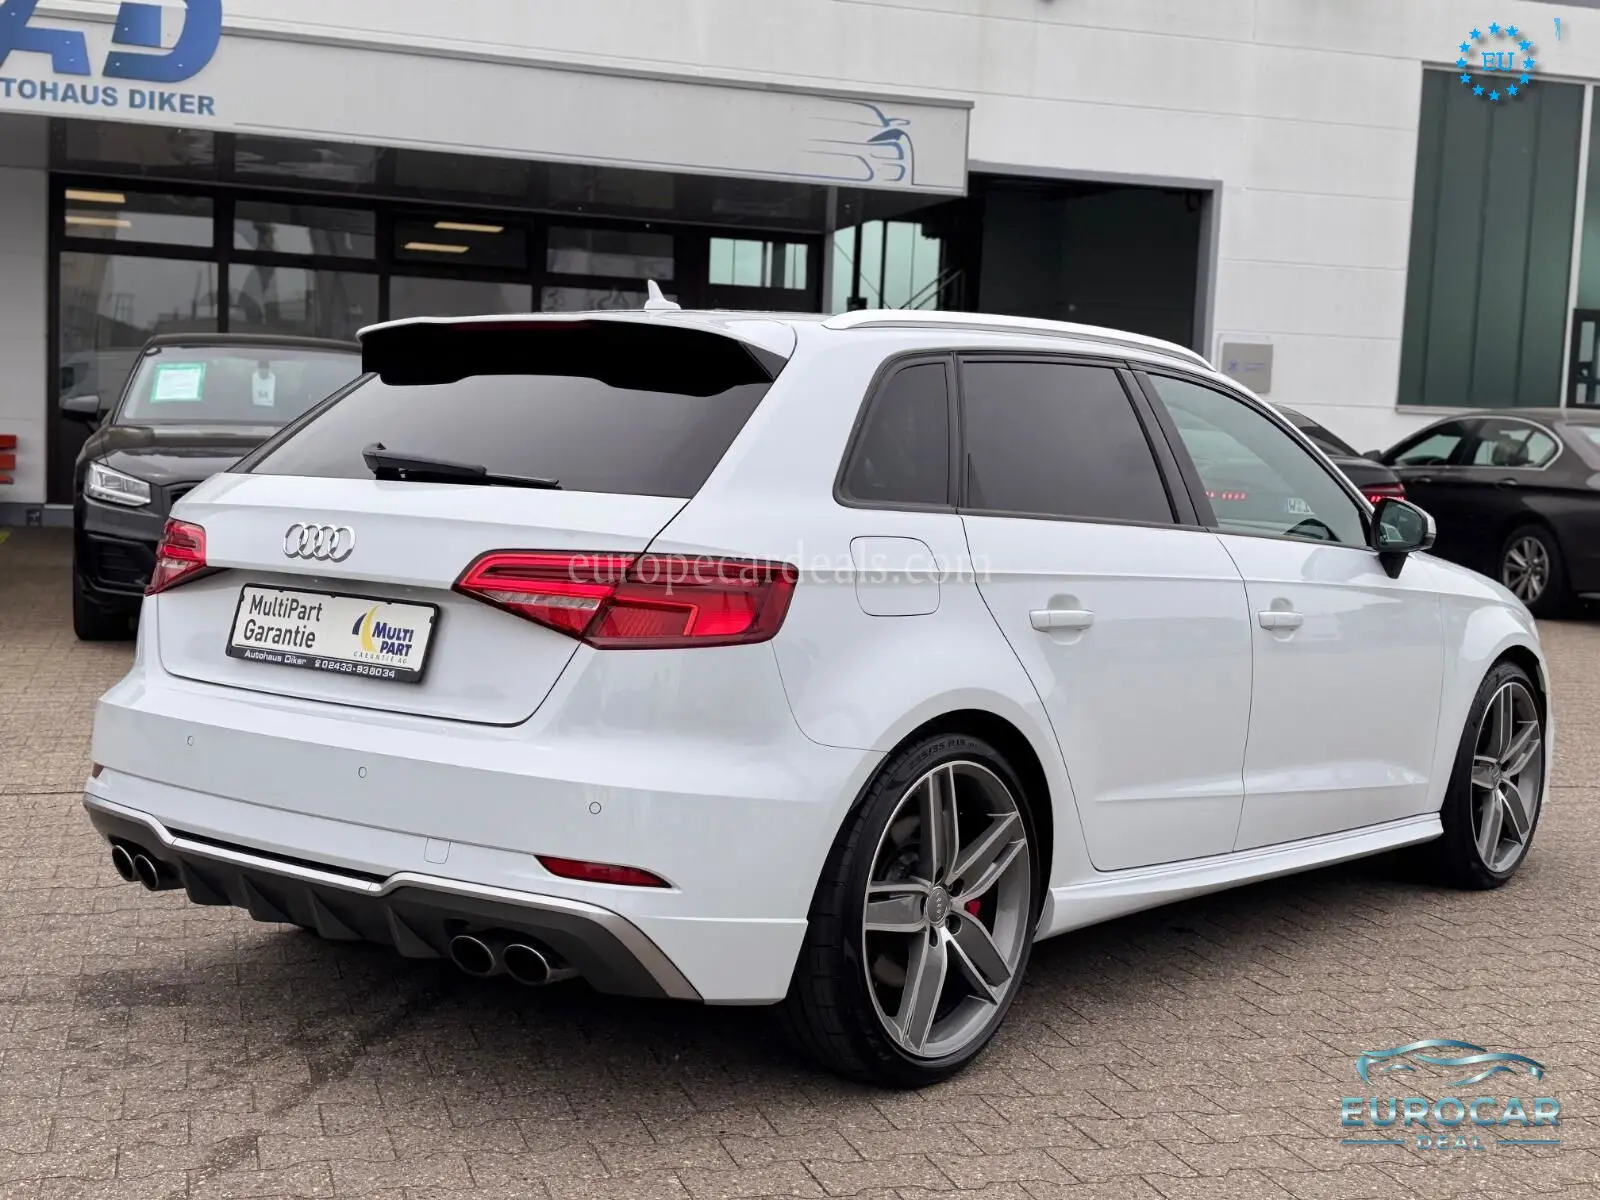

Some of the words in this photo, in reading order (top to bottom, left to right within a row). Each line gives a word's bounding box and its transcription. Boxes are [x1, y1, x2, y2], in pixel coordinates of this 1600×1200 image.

[129, 88, 216, 116] DIKER
[249, 594, 323, 622] MultiPart
[243, 619, 316, 648] Garantie
[371, 621, 415, 642] MULTI
[244, 649, 282, 662] Autohaus
[284, 656, 307, 665] Diker
[380, 640, 413, 656] PART
